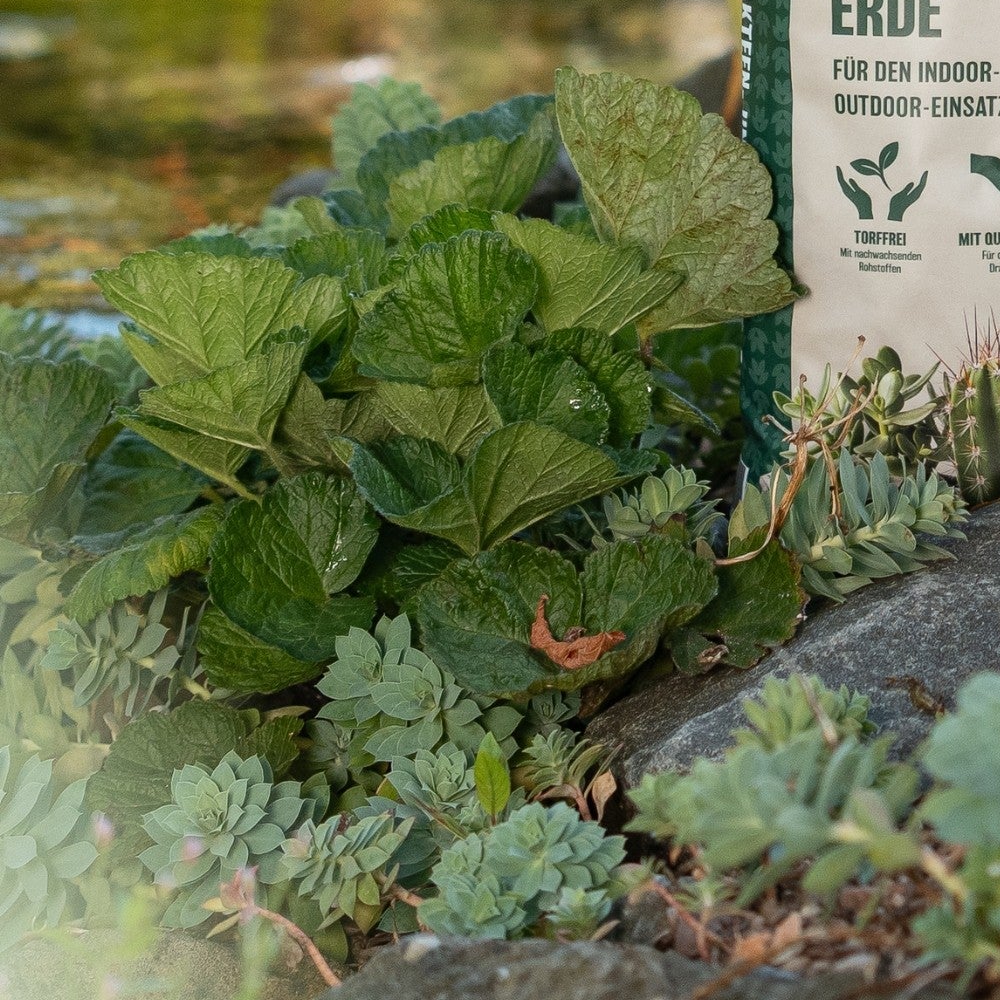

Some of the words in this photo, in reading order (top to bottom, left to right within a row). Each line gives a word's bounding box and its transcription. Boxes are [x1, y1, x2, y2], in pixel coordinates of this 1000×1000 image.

[833, 56, 869, 82] FÜR
[874, 60, 912, 83] DEN
[918, 60, 1000, 83] INDOOR-
[854, 230, 907, 247] TORFFREI
[958, 232, 982, 247] MIT
[840, 248, 852, 258] Mit
[854, 249, 922, 261] nachwachsenden
[982, 249, 995, 260] Für
[858, 261, 902, 274] Rohstoffen
